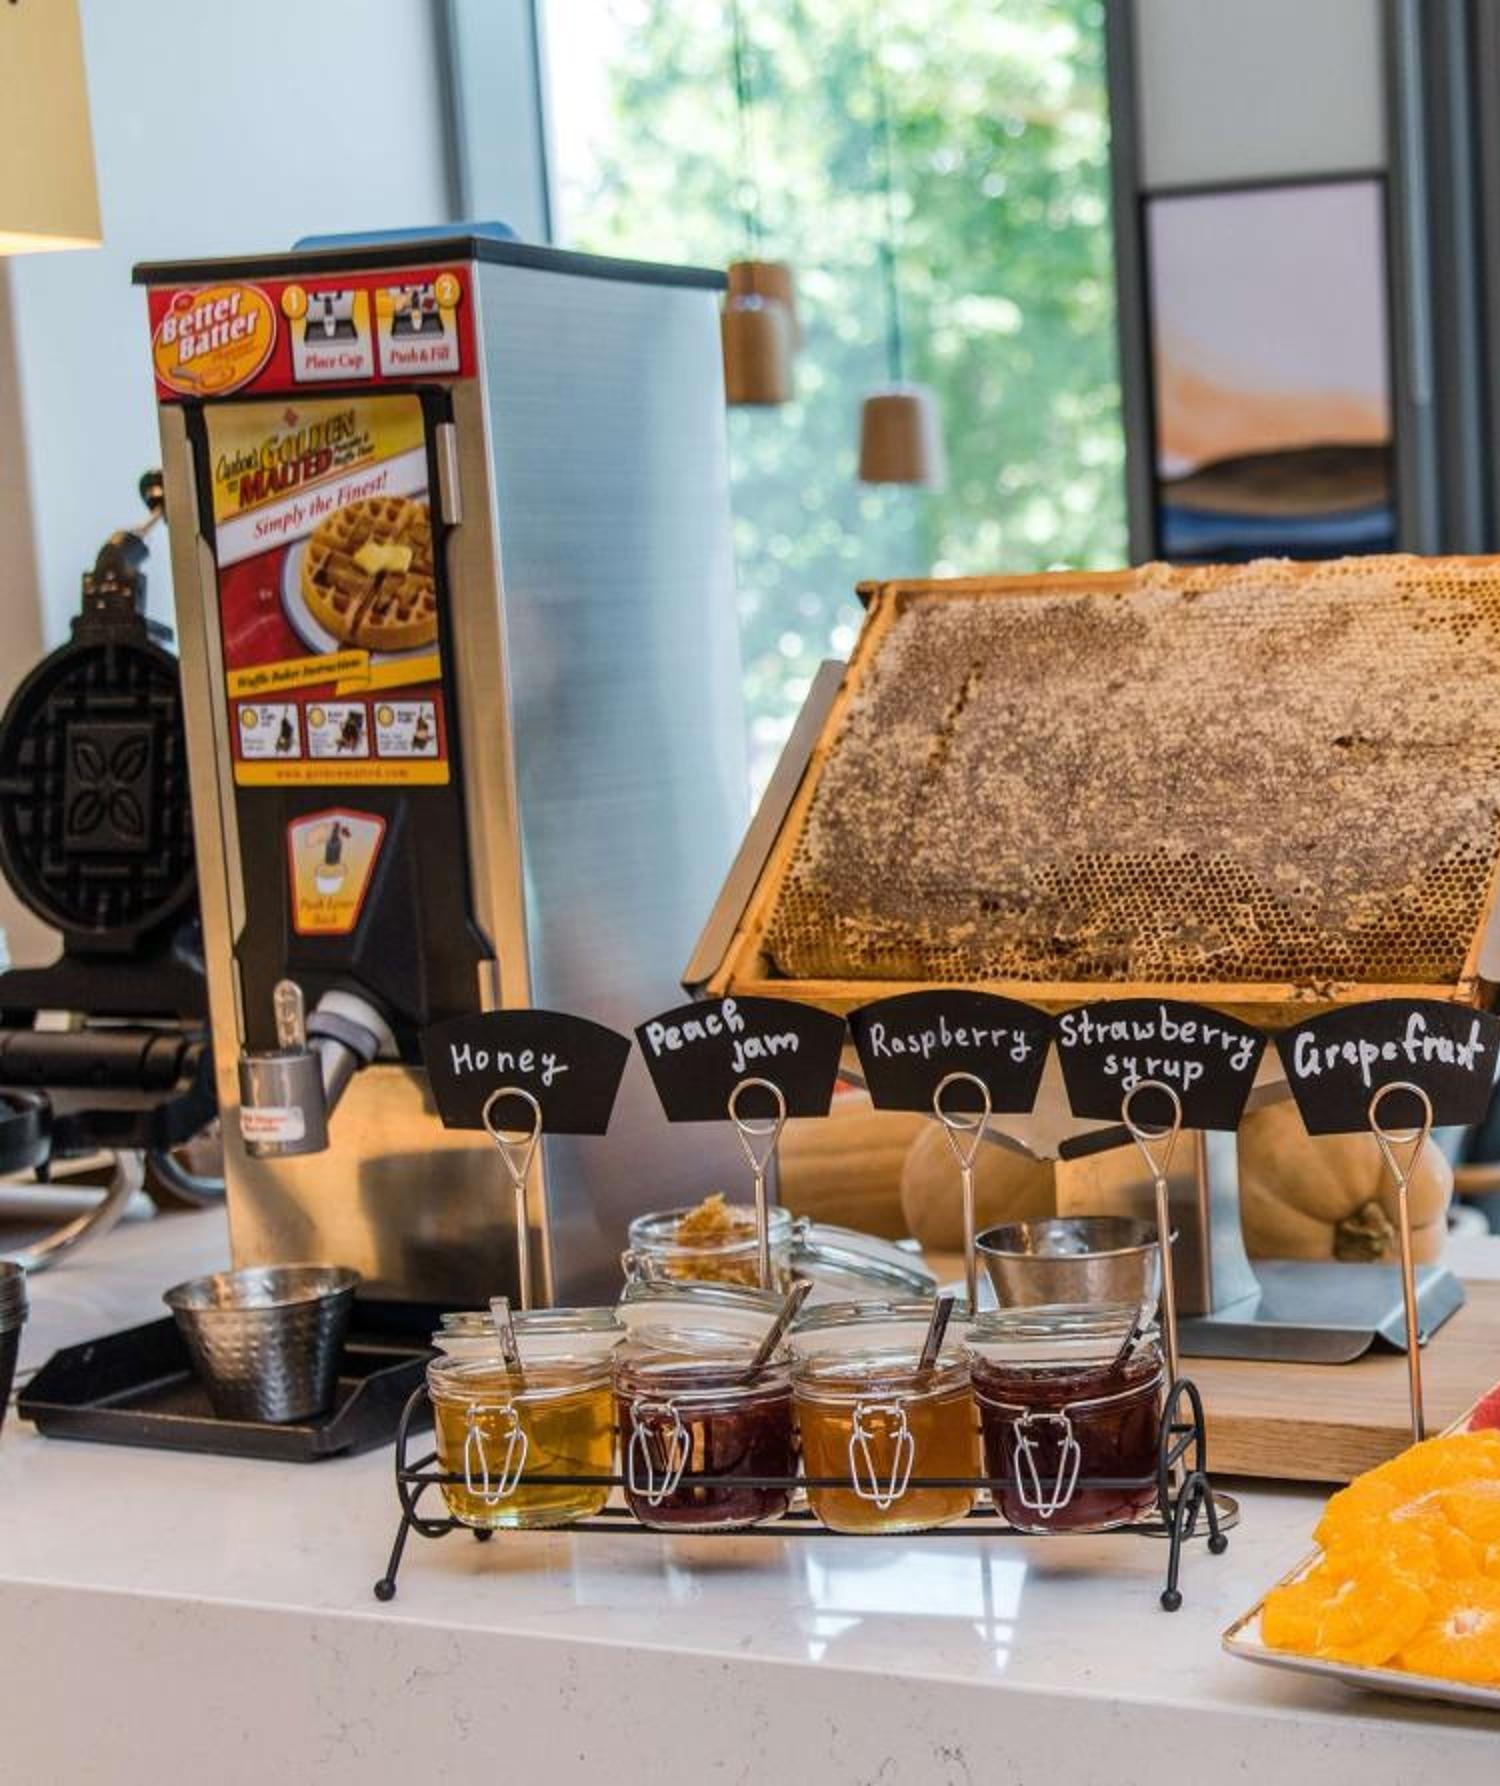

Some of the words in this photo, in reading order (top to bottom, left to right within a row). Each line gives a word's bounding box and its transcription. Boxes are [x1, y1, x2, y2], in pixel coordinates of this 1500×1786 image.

[161, 291, 241, 345] Better
[179, 309, 258, 364] Batter
[305, 354, 336, 370] Place
[339, 353, 364, 371] Cup
[240, 447, 333, 509] MALTED
[254, 503, 306, 539] Simply
[309, 496, 332, 517] the
[337, 470, 388, 505] Finest!
[645, 998, 745, 1057] Peach
[731, 1032, 799, 1074] jam
[870, 1016, 1031, 1064] Raspberry
[1059, 1005, 1256, 1071] Strawberry
[451, 1043, 568, 1086] Honey
[1104, 1054, 1204, 1092] syrup
